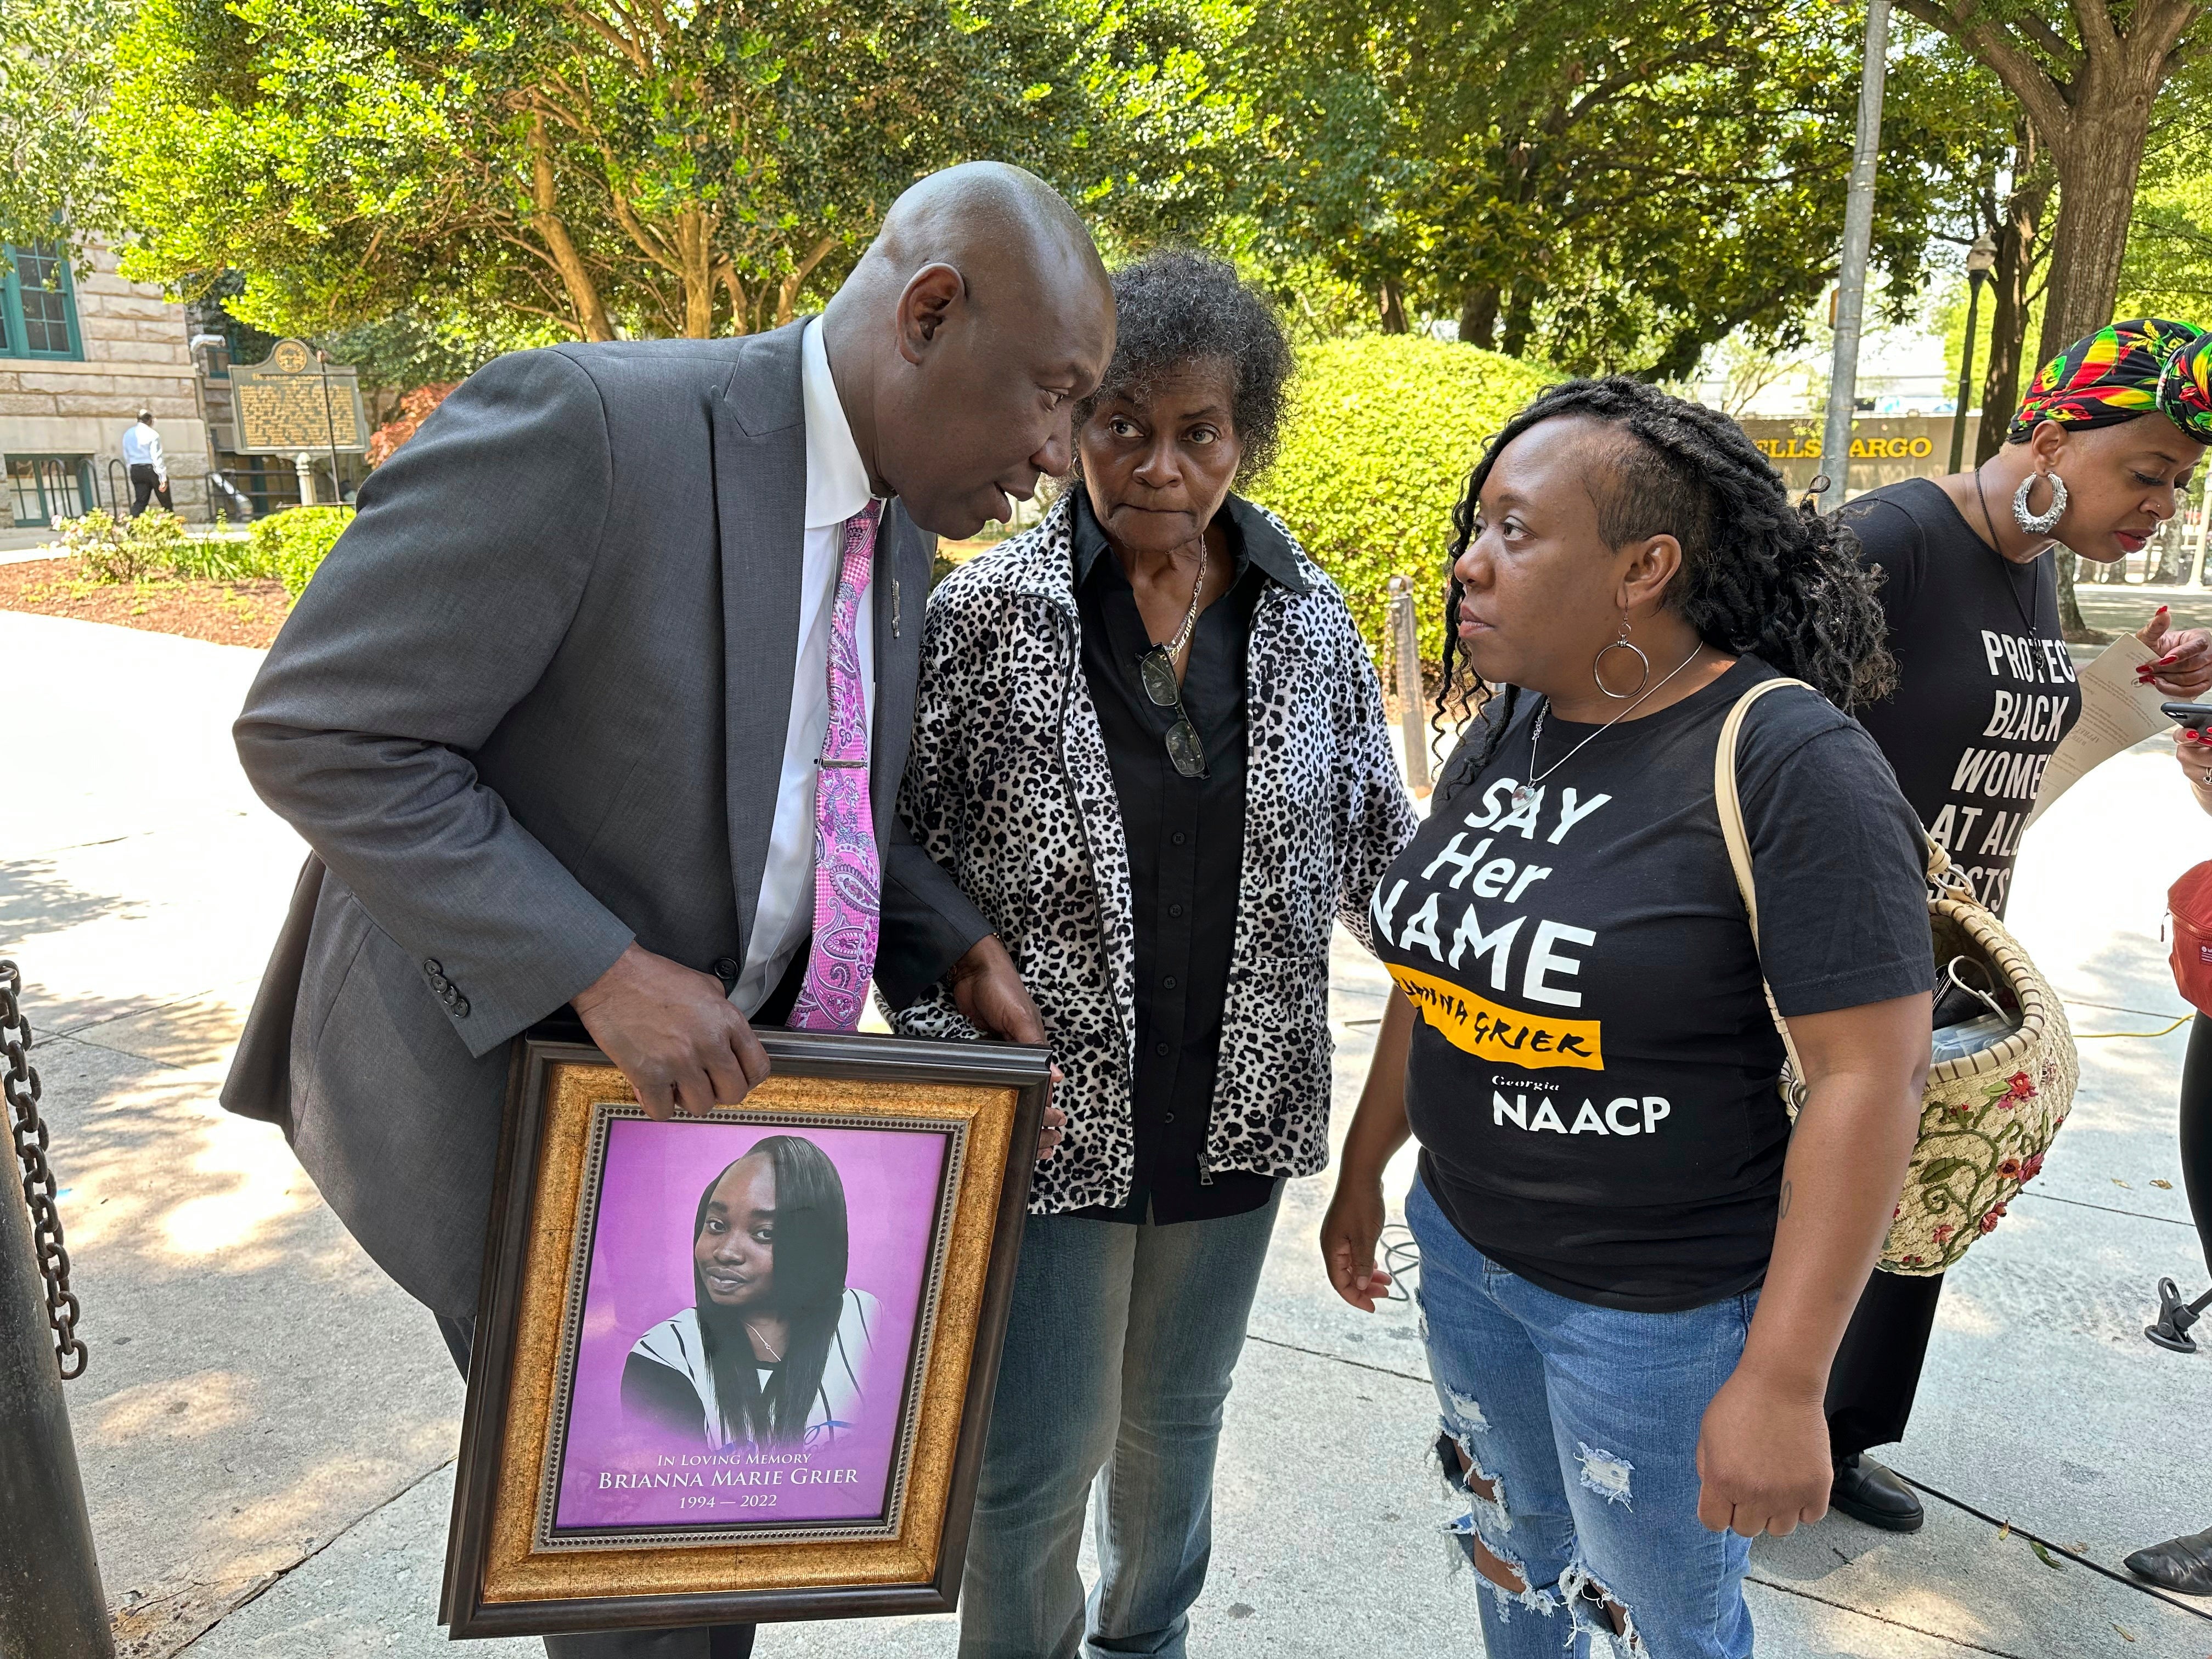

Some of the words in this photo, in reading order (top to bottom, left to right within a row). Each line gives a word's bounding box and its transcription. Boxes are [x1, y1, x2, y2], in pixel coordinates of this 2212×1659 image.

[1753, 438, 1822, 458] ELLS
[1849, 437, 1932, 459] ARGO
[1983, 690, 2069, 742] BLACK
[1951, 748, 2051, 800] WOME
[1464, 777, 1612, 845] SAY
[1929, 804, 1983, 851] AT
[1421, 832, 1553, 904] Her
[1369, 873, 1596, 1008] NAME
[1475, 1012, 1593, 1058] GRIER
[1492, 1075, 1560, 1092] Georgia
[1493, 1090, 1671, 1136] NAACP
[598, 1472, 703, 1489] BRIANNA
[710, 1470, 783, 1487] MARIE
[790, 1468, 859, 1485] GRIER
[681, 1454, 741, 1466] LOVING
[746, 1453, 811, 1465] MEMORY
[680, 1496, 715, 1509] 1994
[740, 1494, 777, 1507] 2022
